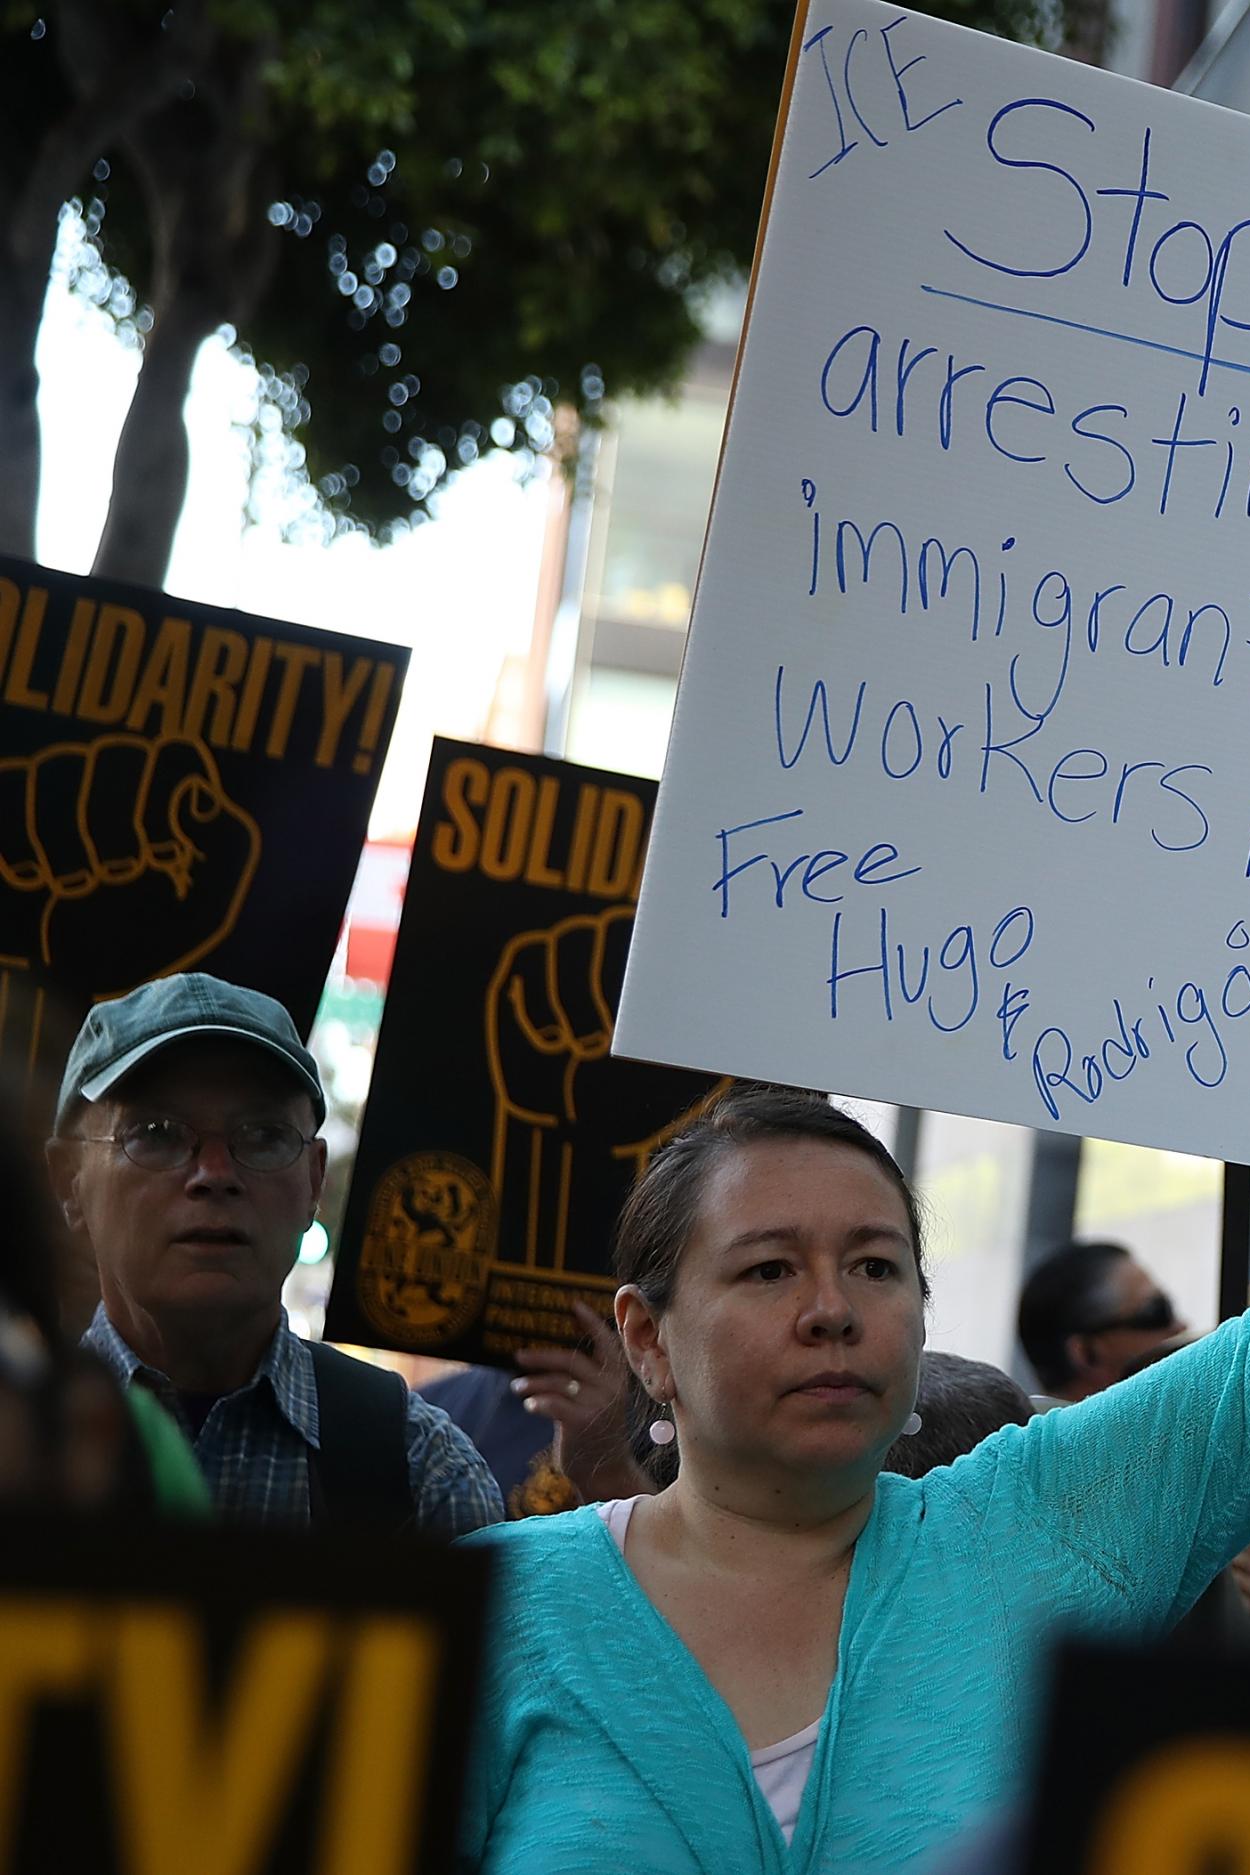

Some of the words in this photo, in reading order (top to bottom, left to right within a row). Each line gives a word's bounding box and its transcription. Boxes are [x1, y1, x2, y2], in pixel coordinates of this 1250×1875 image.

[803, 16, 963, 180] ICE
[432, 757, 650, 904] SOLID
[711, 810, 922, 918] Free
[827, 906, 1034, 1031] Hugo
